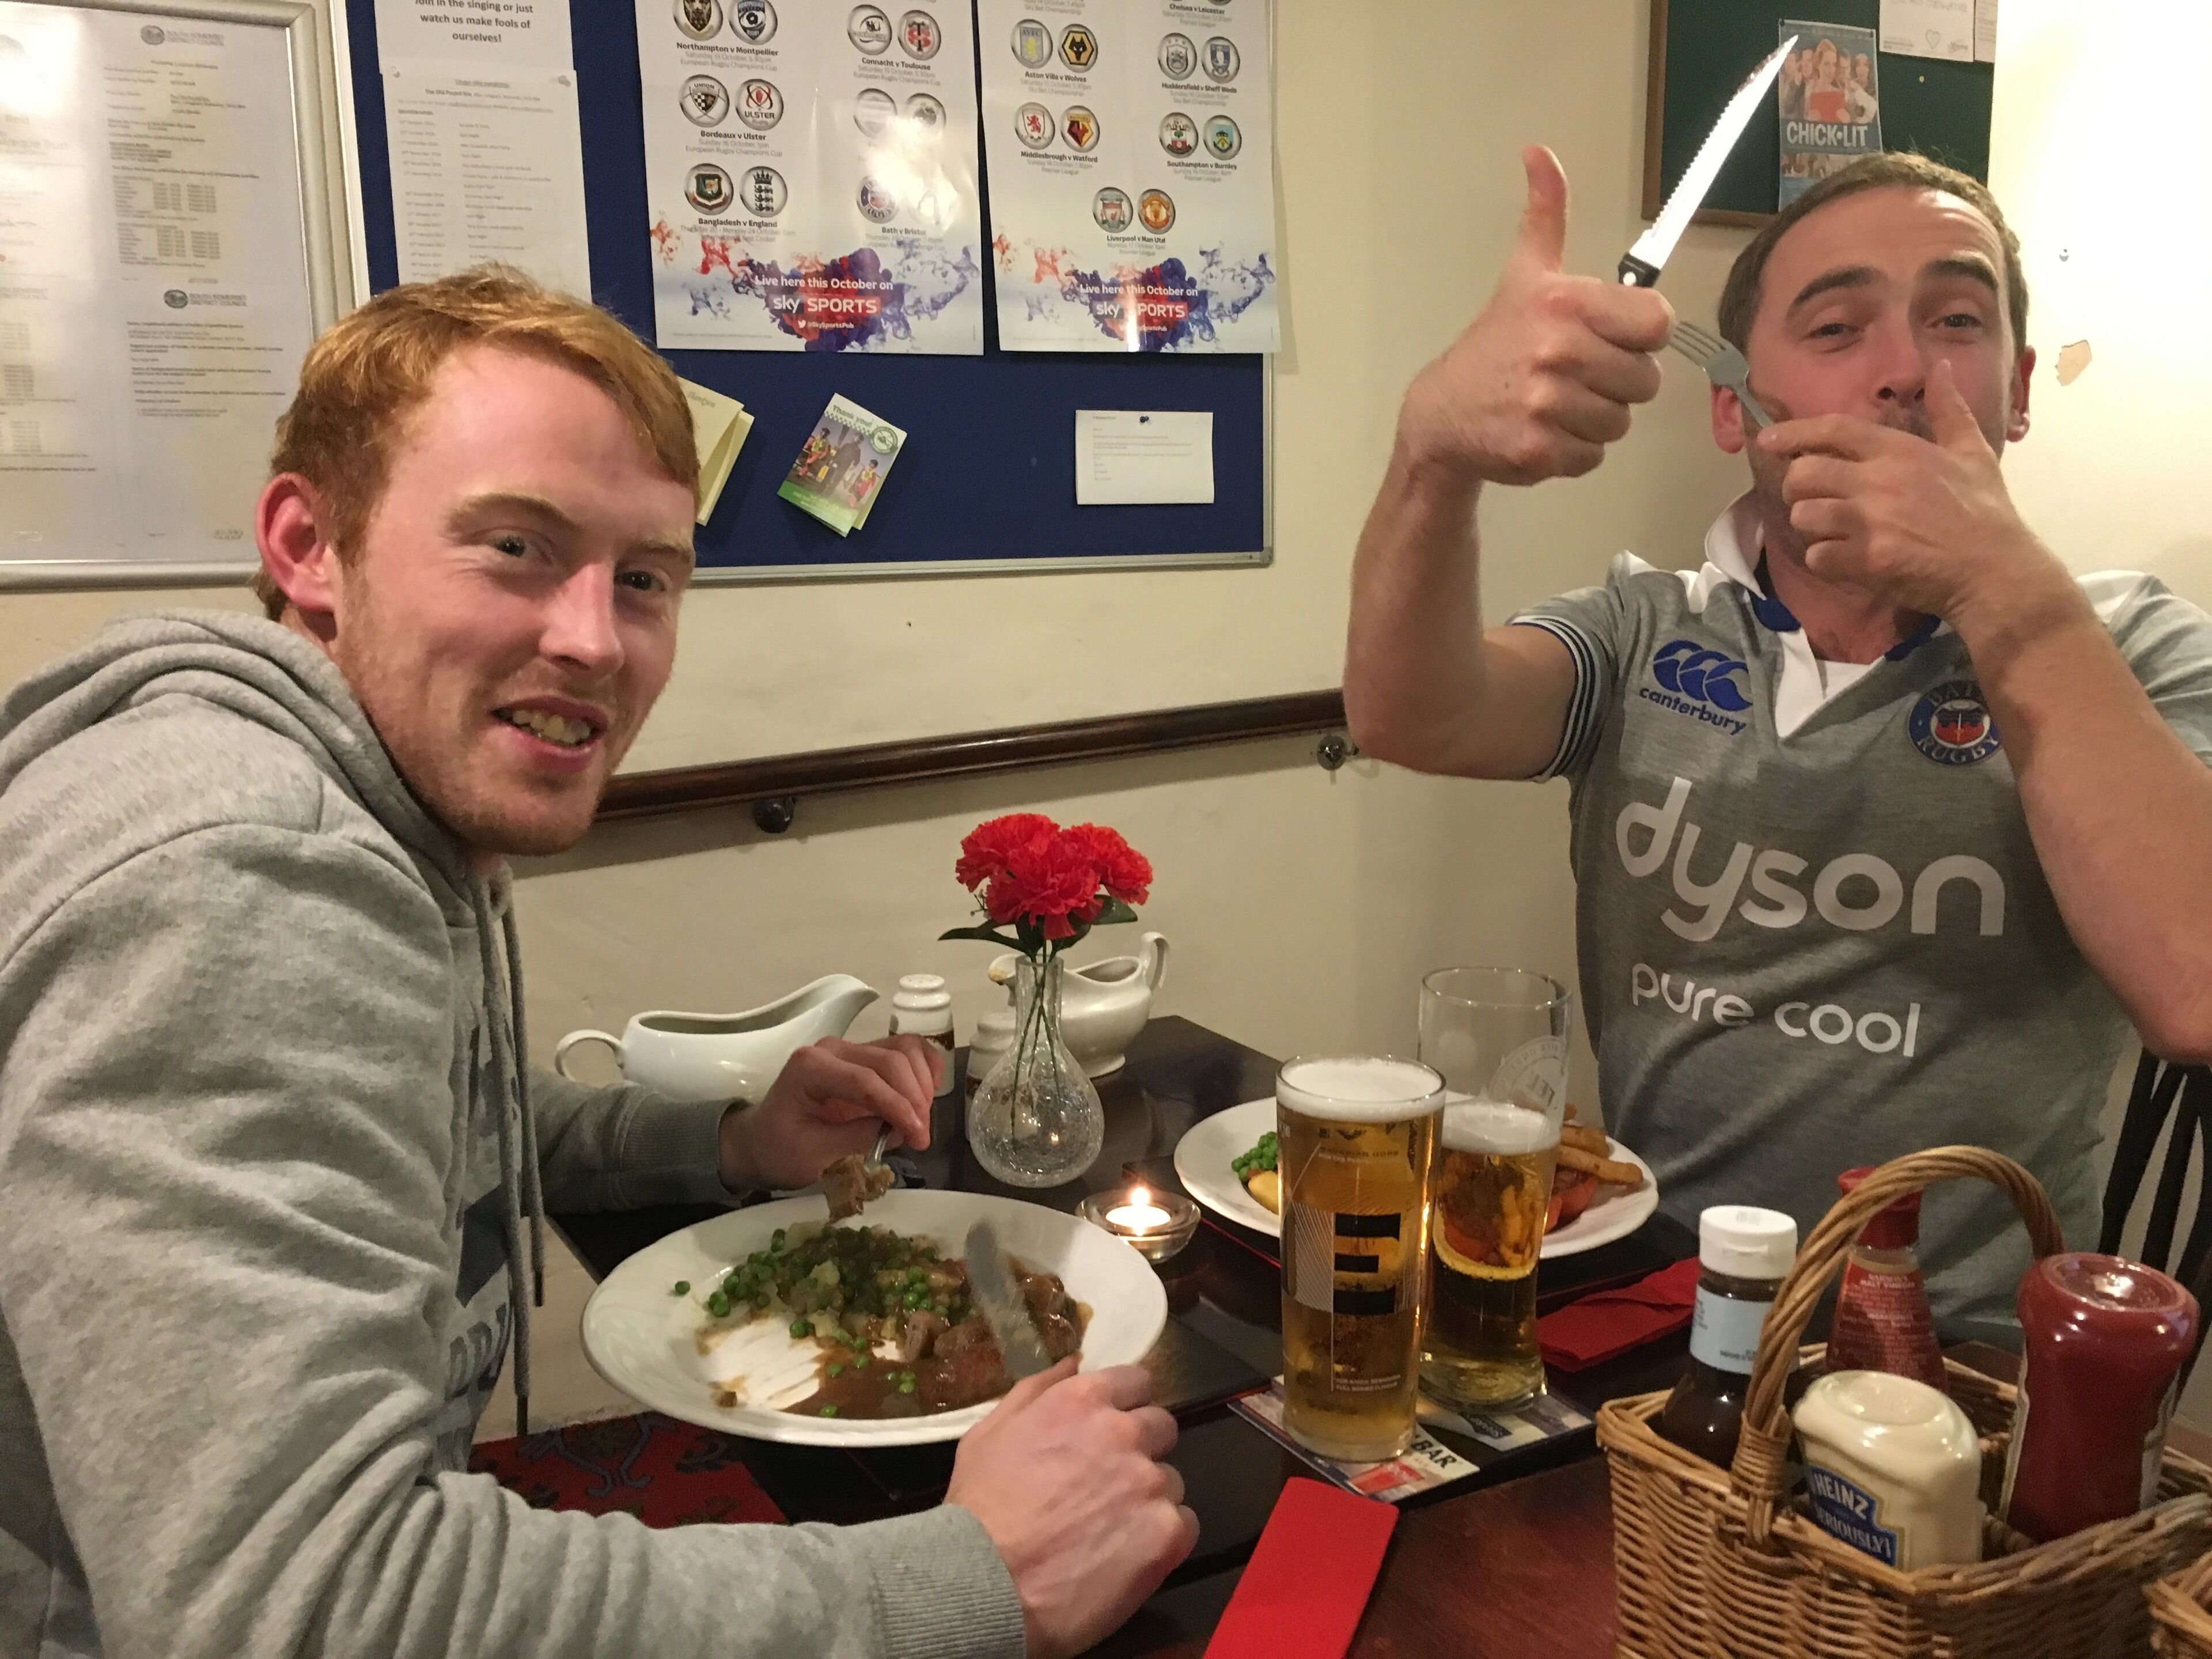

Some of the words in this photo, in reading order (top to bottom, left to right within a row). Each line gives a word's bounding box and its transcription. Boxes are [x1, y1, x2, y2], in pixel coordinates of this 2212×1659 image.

[448, 0, 465, 8] the
[467, 0, 501, 12] singing
[516, 3, 534, 13] just
[1169, 3, 1192, 12] Chelsea
[1199, 6, 1225, 14] Leicester
[420, 14, 450, 23] watch
[452, 16, 464, 24] us
[465, 17, 493, 26] make
[495, 18, 518, 28] fools
[520, 20, 531, 29] of
[452, 32, 502, 43] ourselves!
[676, 41, 729, 53] Northampton
[736, 46, 779, 56] Montpellier
[862, 58, 894, 67] Connacht
[901, 61, 931, 70] Toulouse
[1025, 71, 1044, 79] Aston
[1065, 74, 1087, 82] Wolves
[1161, 82, 1200, 90] Huddersfield
[744, 110, 775, 119] ULSTER
[700, 130, 736, 138] Bordeaux
[685, 145, 715, 153] European
[736, 148, 770, 156] Champions
[770, 150, 783, 158] Cup
[1021, 151, 1067, 162] Middlesbrough
[1073, 154, 1099, 163] Watford
[1167, 160, 1209, 169] Southampton
[698, 218, 741, 228] Bangladesh
[748, 220, 778, 229] England
[881, 226, 898, 234] Bath
[755, 275, 779, 286] Live
[781, 275, 805, 287] here
[808, 276, 828, 289] this
[830, 278, 877, 290] October
[879, 282, 893, 290] on
[1080, 283, 1100, 294] Live
[1102, 284, 1124, 294] here
[1126, 284, 1146, 295] this
[1146, 285, 1184, 296] October
[772, 294, 800, 313] sky
[807, 297, 878, 313] SPORTS
[1096, 301, 1120, 318] sky
[1127, 302, 1186, 318] PORTS
[833, 404, 854, 419] Thank
[1638, 687, 1747, 736] canterbury
[1916, 732, 1999, 763] RUGBY
[1615, 776, 2006, 942] dyson
[1632, 963, 1755, 1026] pure
[1774, 1002, 1921, 1057] cool
[1411, 1440, 1457, 1469] BAR
[1814, 1472, 1869, 1521] HEINZ
